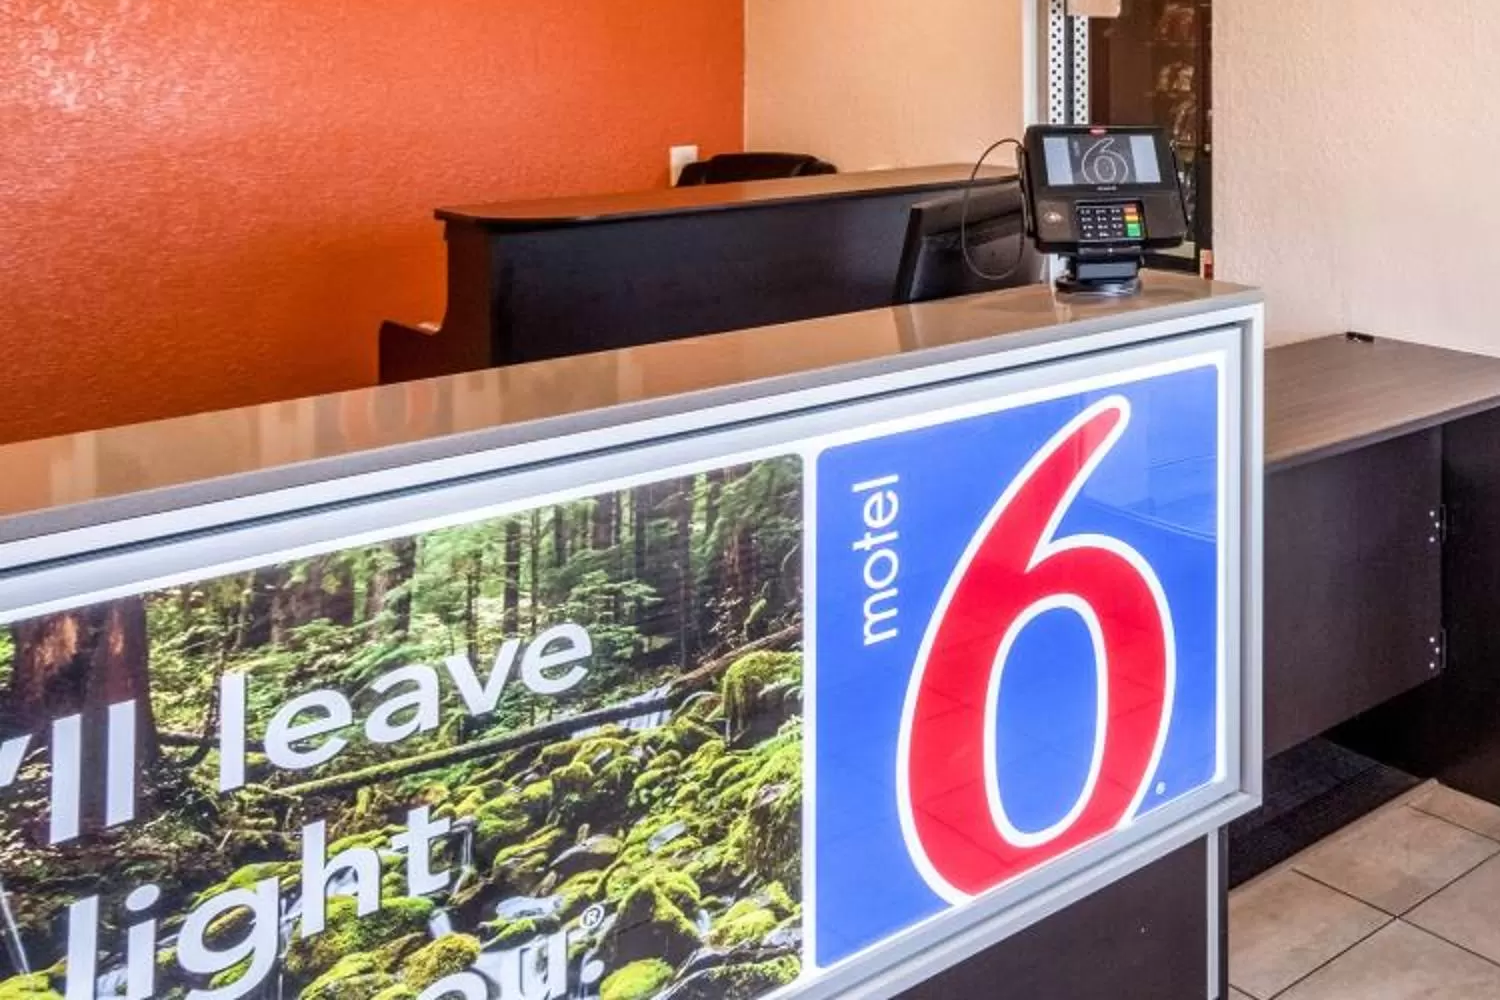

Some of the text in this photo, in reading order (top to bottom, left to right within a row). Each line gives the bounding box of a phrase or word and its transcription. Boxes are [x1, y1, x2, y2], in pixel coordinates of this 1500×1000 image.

[1081, 136, 1129, 185] 6
[852, 473, 899, 646] motel
[218, 622, 594, 793] leave
[897, 393, 1177, 908] 6
[64, 804, 456, 1000] light
